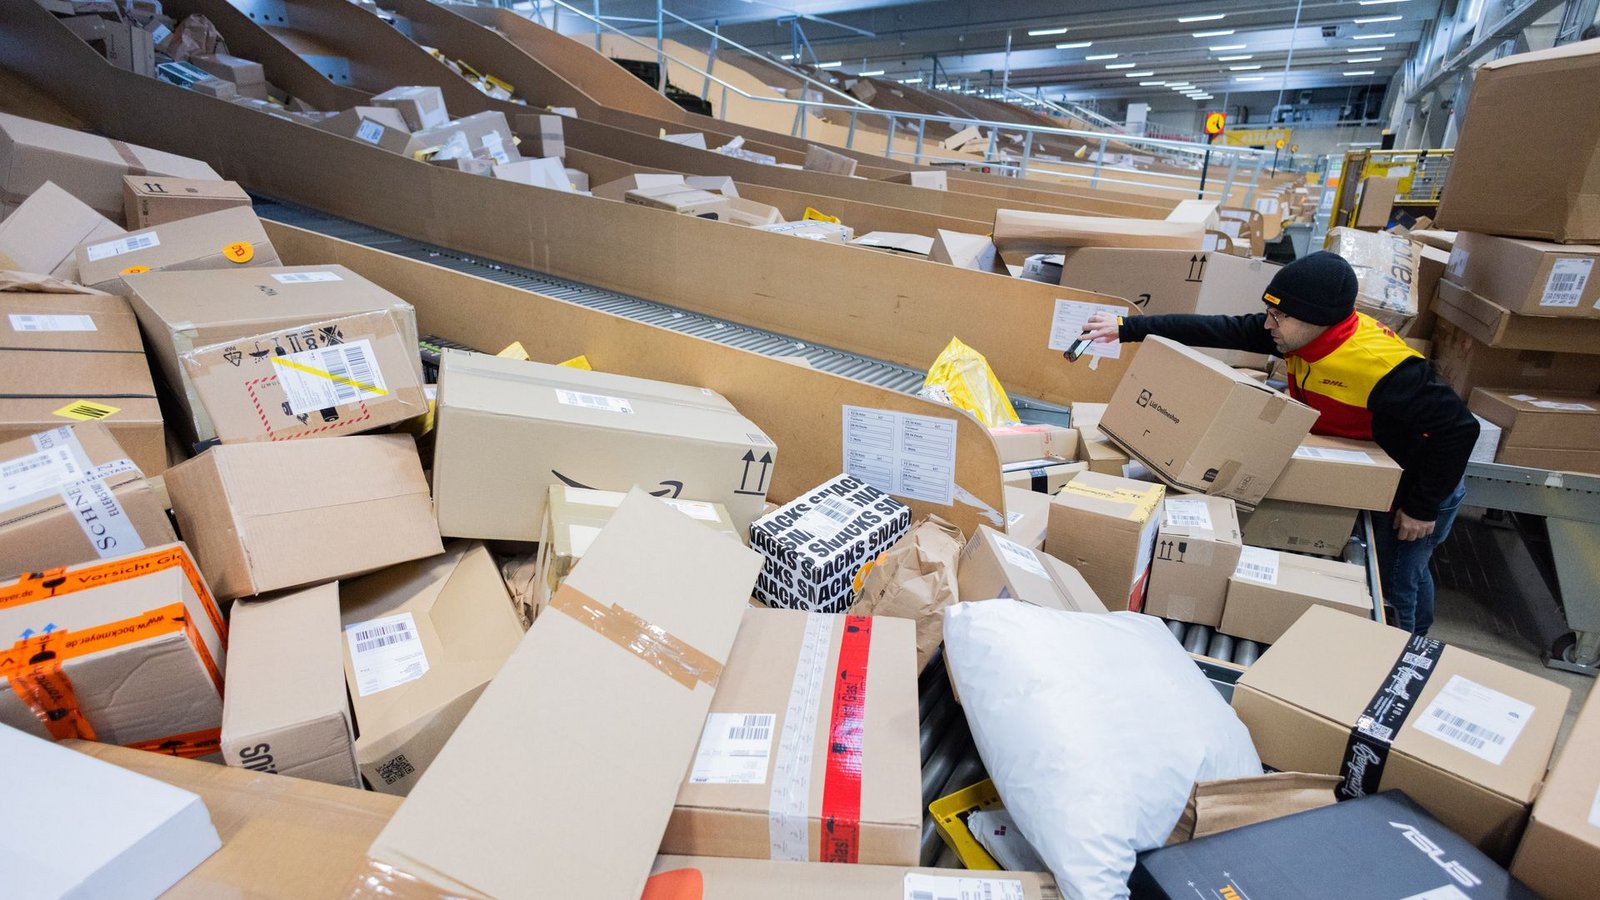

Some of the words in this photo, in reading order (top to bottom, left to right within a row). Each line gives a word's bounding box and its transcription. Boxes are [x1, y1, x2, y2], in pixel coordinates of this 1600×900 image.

[1320, 379, 1348, 388] DHL
[1150, 401, 1158, 411] Lidl
[1157, 405, 1180, 424] Onlineshop
[78, 561, 151, 585] Vorsicht
[65, 615, 165, 649] www.bockmeyer.de
[1388, 821, 1483, 888] ASUS
